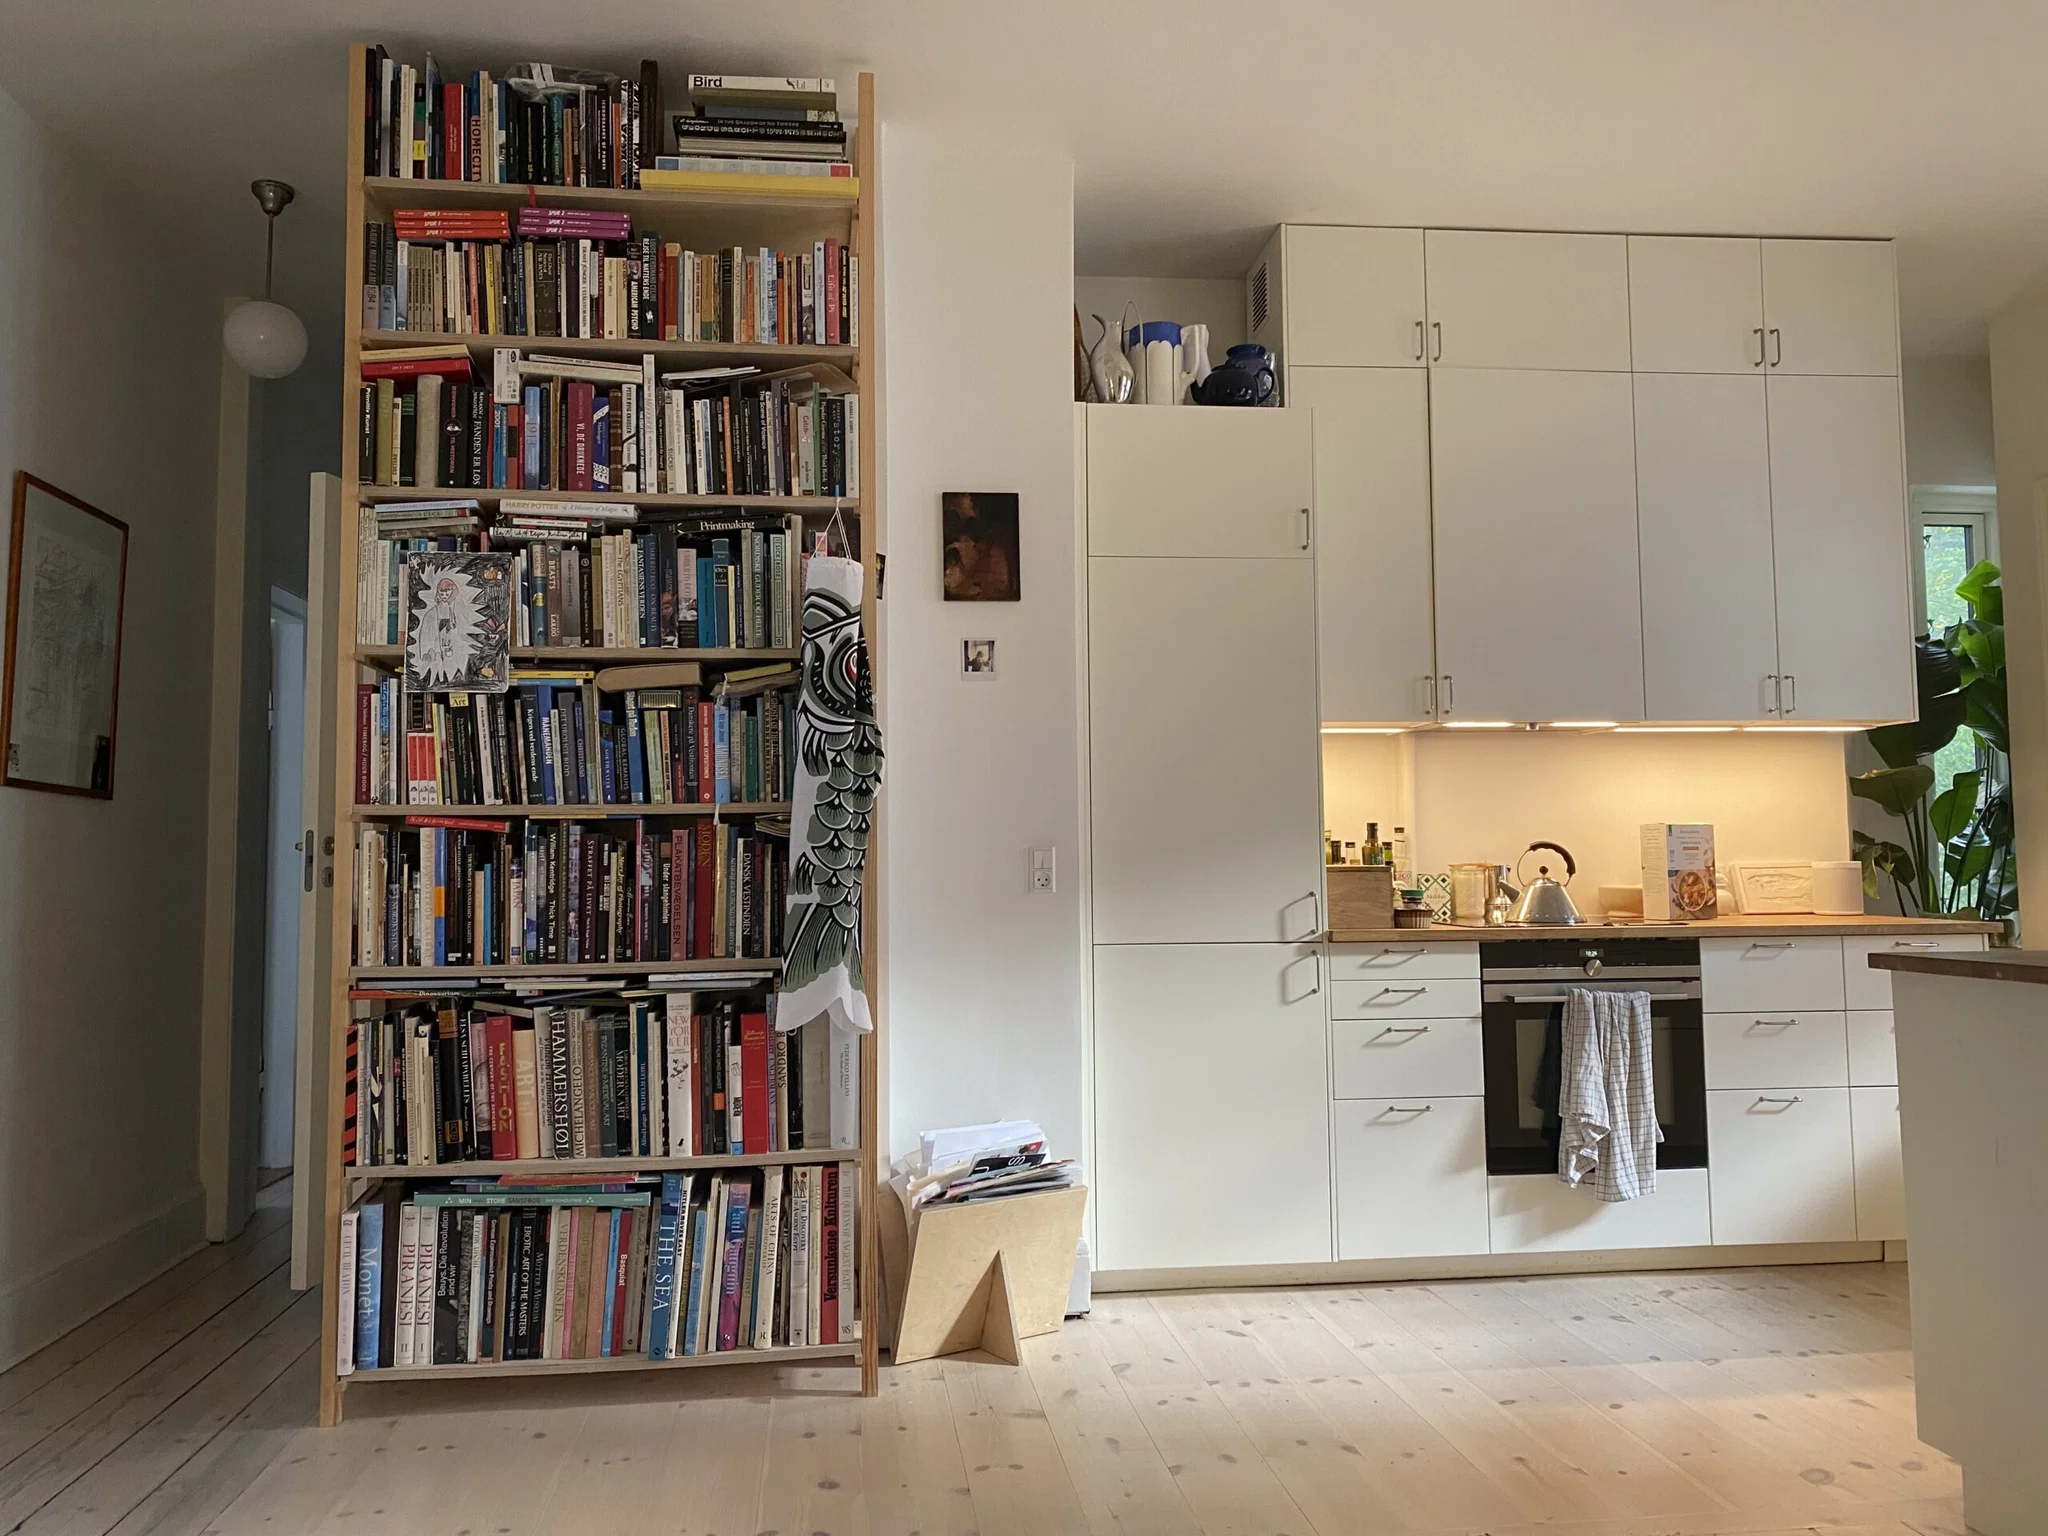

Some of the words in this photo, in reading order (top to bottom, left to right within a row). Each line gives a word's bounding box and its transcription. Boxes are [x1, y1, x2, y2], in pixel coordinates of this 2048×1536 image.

[694, 77, 722, 88] Bird
[472, 119, 481, 182] HOMECITY
[828, 274, 836, 291] Life
[828, 304, 836, 312] Pi
[473, 421, 481, 454] FANDEN
[526, 421, 537, 446] 1913
[575, 423, 584, 432] VI,
[576, 433, 584, 441] DE
[473, 457, 480, 466] ER
[576, 443, 584, 474] DRUKNEDE
[700, 520, 755, 531] Printmaking
[755, 602, 762, 614] OG
[526, 709, 534, 730] Krigen
[542, 717, 553, 764] MÅNEMANDEN
[687, 736, 694, 744] på
[548, 861, 556, 894] Kentridge
[743, 853, 751, 882] DANSK
[587, 881, 595, 890] PÅ
[673, 836, 682, 945] PLAKATBEVÆGELSEN
[660, 883, 670, 924] slangehimlen
[743, 884, 751, 935] VESTINDIEN
[459, 1019, 467, 1040] ELSA
[516, 1060, 533, 1097] ART
[616, 1050, 624, 1096] MODERN
[776, 1042, 786, 1088] SANDRO
[552, 1020, 569, 1149] HAMMERSHØI
[572, 1067, 584, 1156] MICHELANGELO
[616, 1099, 625, 1120] ART
[824, 1172, 837, 1226] Kulturen
[842, 1186, 851, 1199] THE
[731, 1205, 745, 1233] Paul
[770, 1196, 778, 1221] ARTS
[842, 1200, 851, 1225] QUEENS
[440, 1211, 448, 1252] Revolution
[522, 1226, 531, 1254] EROTIC
[657, 1222, 676, 1266] THE
[769, 1224, 776, 1239] OF
[800, 1216, 808, 1251] DISCOVERY
[842, 1227, 851, 1237] OF
[343, 1236, 353, 1259] CECIL
[439, 1255, 447, 1268] Die
[488, 1240, 496, 1273] Expressionist
[766, 1242, 775, 1275] CHINA
[842, 1240, 851, 1268] ANCIENT
[342, 1262, 353, 1295] BEATON
[521, 1272, 530, 1283] OF
[522, 1256, 530, 1271] ART
[554, 1224, 568, 1323] VERDENSKUNSTEN
[618, 1254, 627, 1286] Basquiat
[725, 1239, 743, 1296] Gauguin
[744, 1252, 753, 1295] MEZZOTINT
[824, 1231, 837, 1302] Versunkene
[358, 1247, 378, 1316] Monet
[399, 1243, 416, 1327] PIRANESI
[417, 1243, 434, 1327] PIRANESI
[520, 1285, 529, 1300] THE
[653, 1273, 671, 1311] SEA
[842, 1270, 851, 1291] EGYPT
[486, 1301, 494, 1324] Drawings
[518, 1302, 528, 1336] MASTERS
[532, 1288, 542, 1323] MUSEUM
